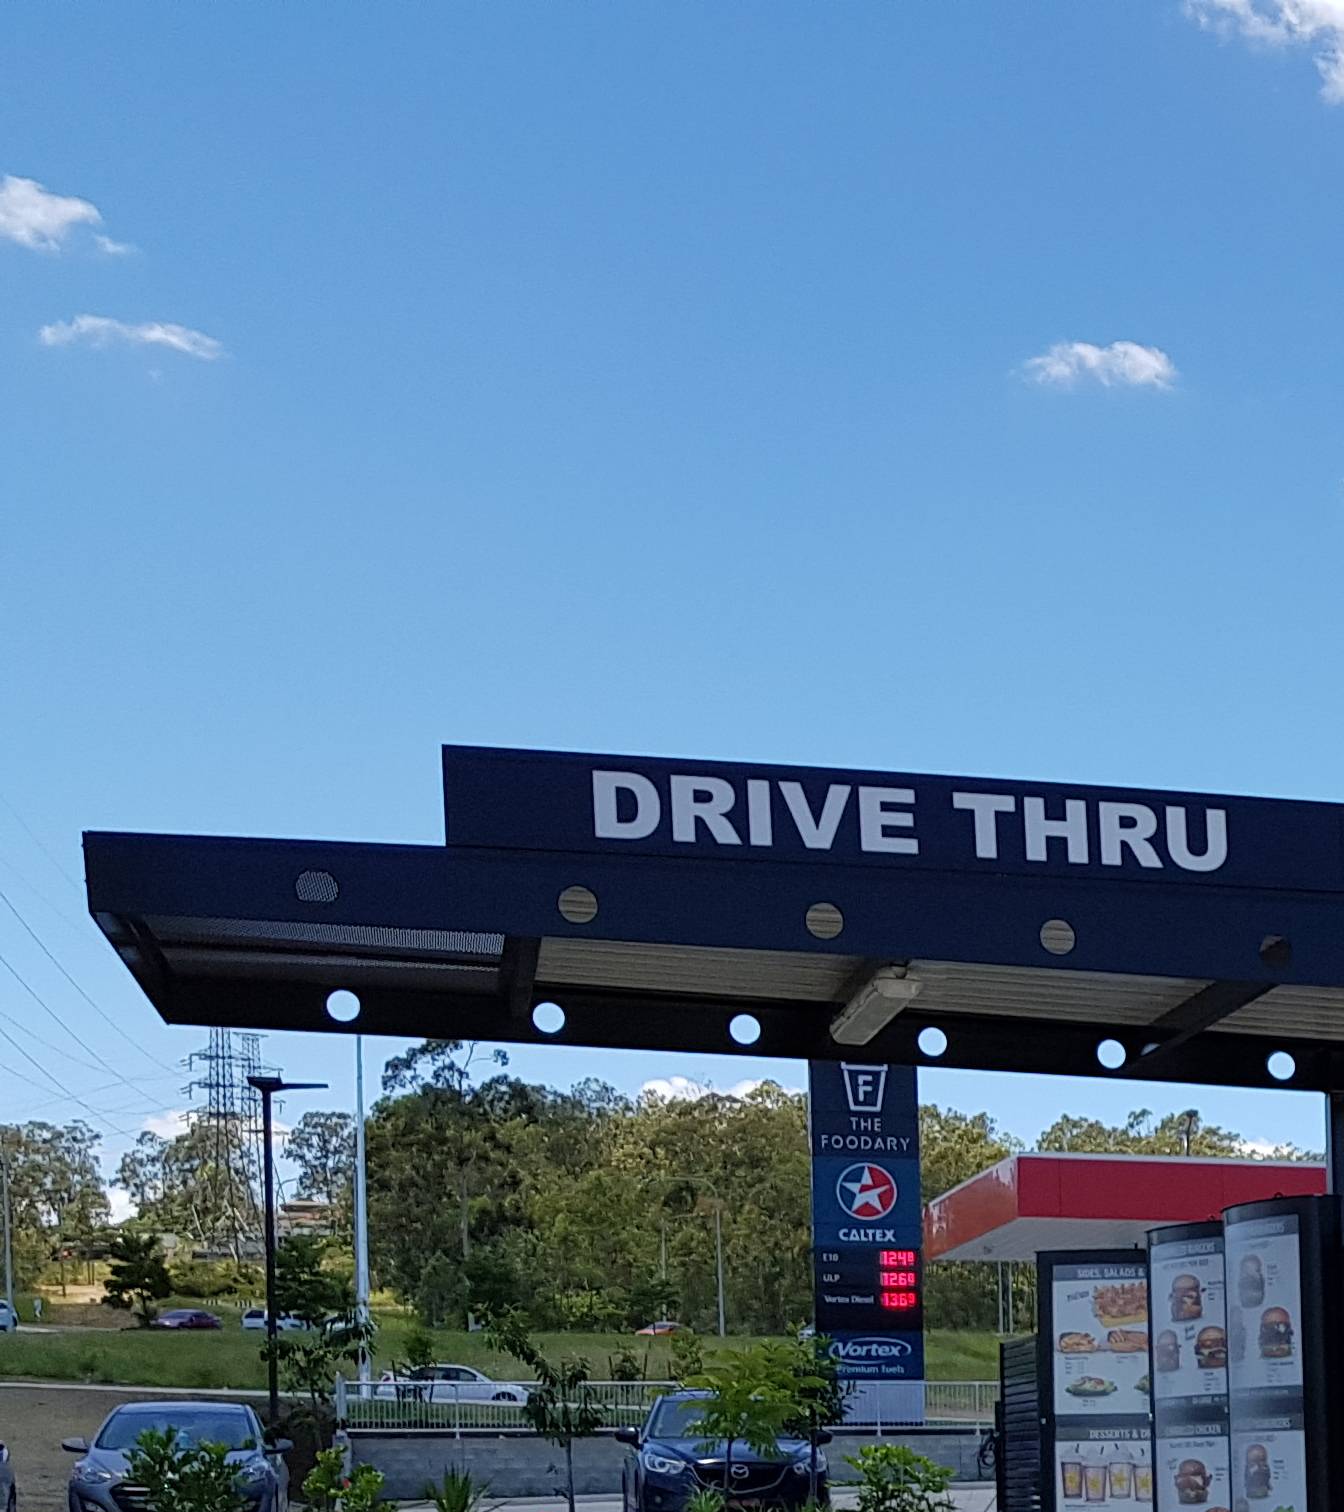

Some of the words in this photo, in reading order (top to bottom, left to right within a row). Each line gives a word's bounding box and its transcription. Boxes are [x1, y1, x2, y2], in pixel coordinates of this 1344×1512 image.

[591, 769, 920, 854] DRIVE
[952, 791, 1228, 872] THRU
[850, 1117, 882, 1132] THE
[821, 1134, 911, 1151] FOODARY
[838, 1228, 896, 1242] CALTEX
[823, 1274, 840, 1282] ULP
[836, 1341, 902, 1357] Vortex
[882, 1364, 905, 1374] fuels
